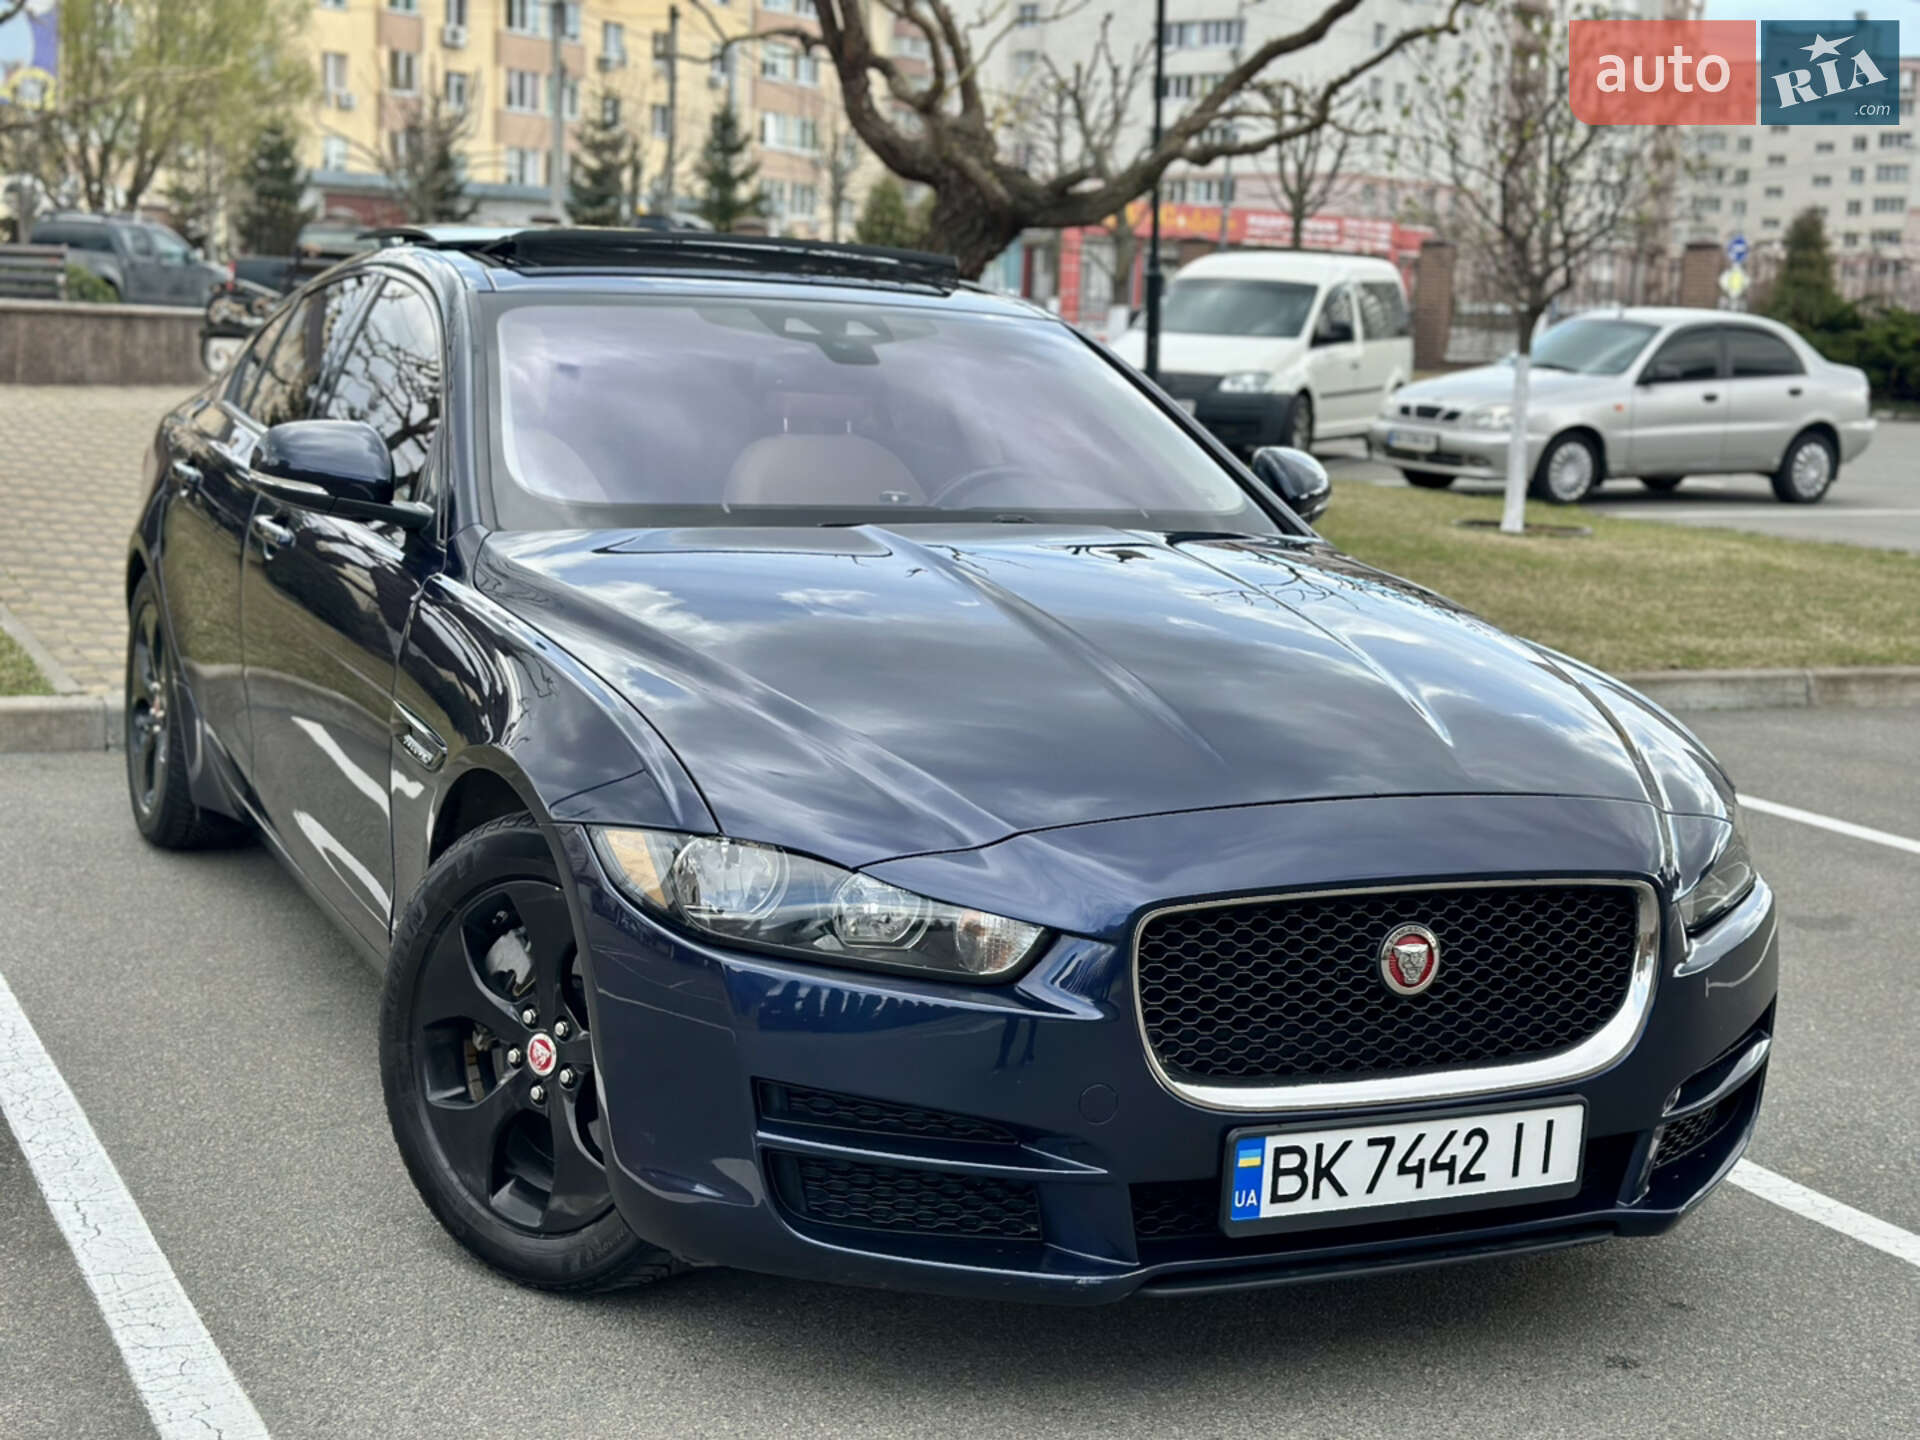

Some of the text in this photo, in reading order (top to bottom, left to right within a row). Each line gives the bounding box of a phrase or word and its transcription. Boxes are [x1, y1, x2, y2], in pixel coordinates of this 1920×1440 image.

[1269, 1140, 1354, 1204] BK
[1365, 1127, 1490, 1195] 7442
[1234, 1189, 1258, 1208] UA
